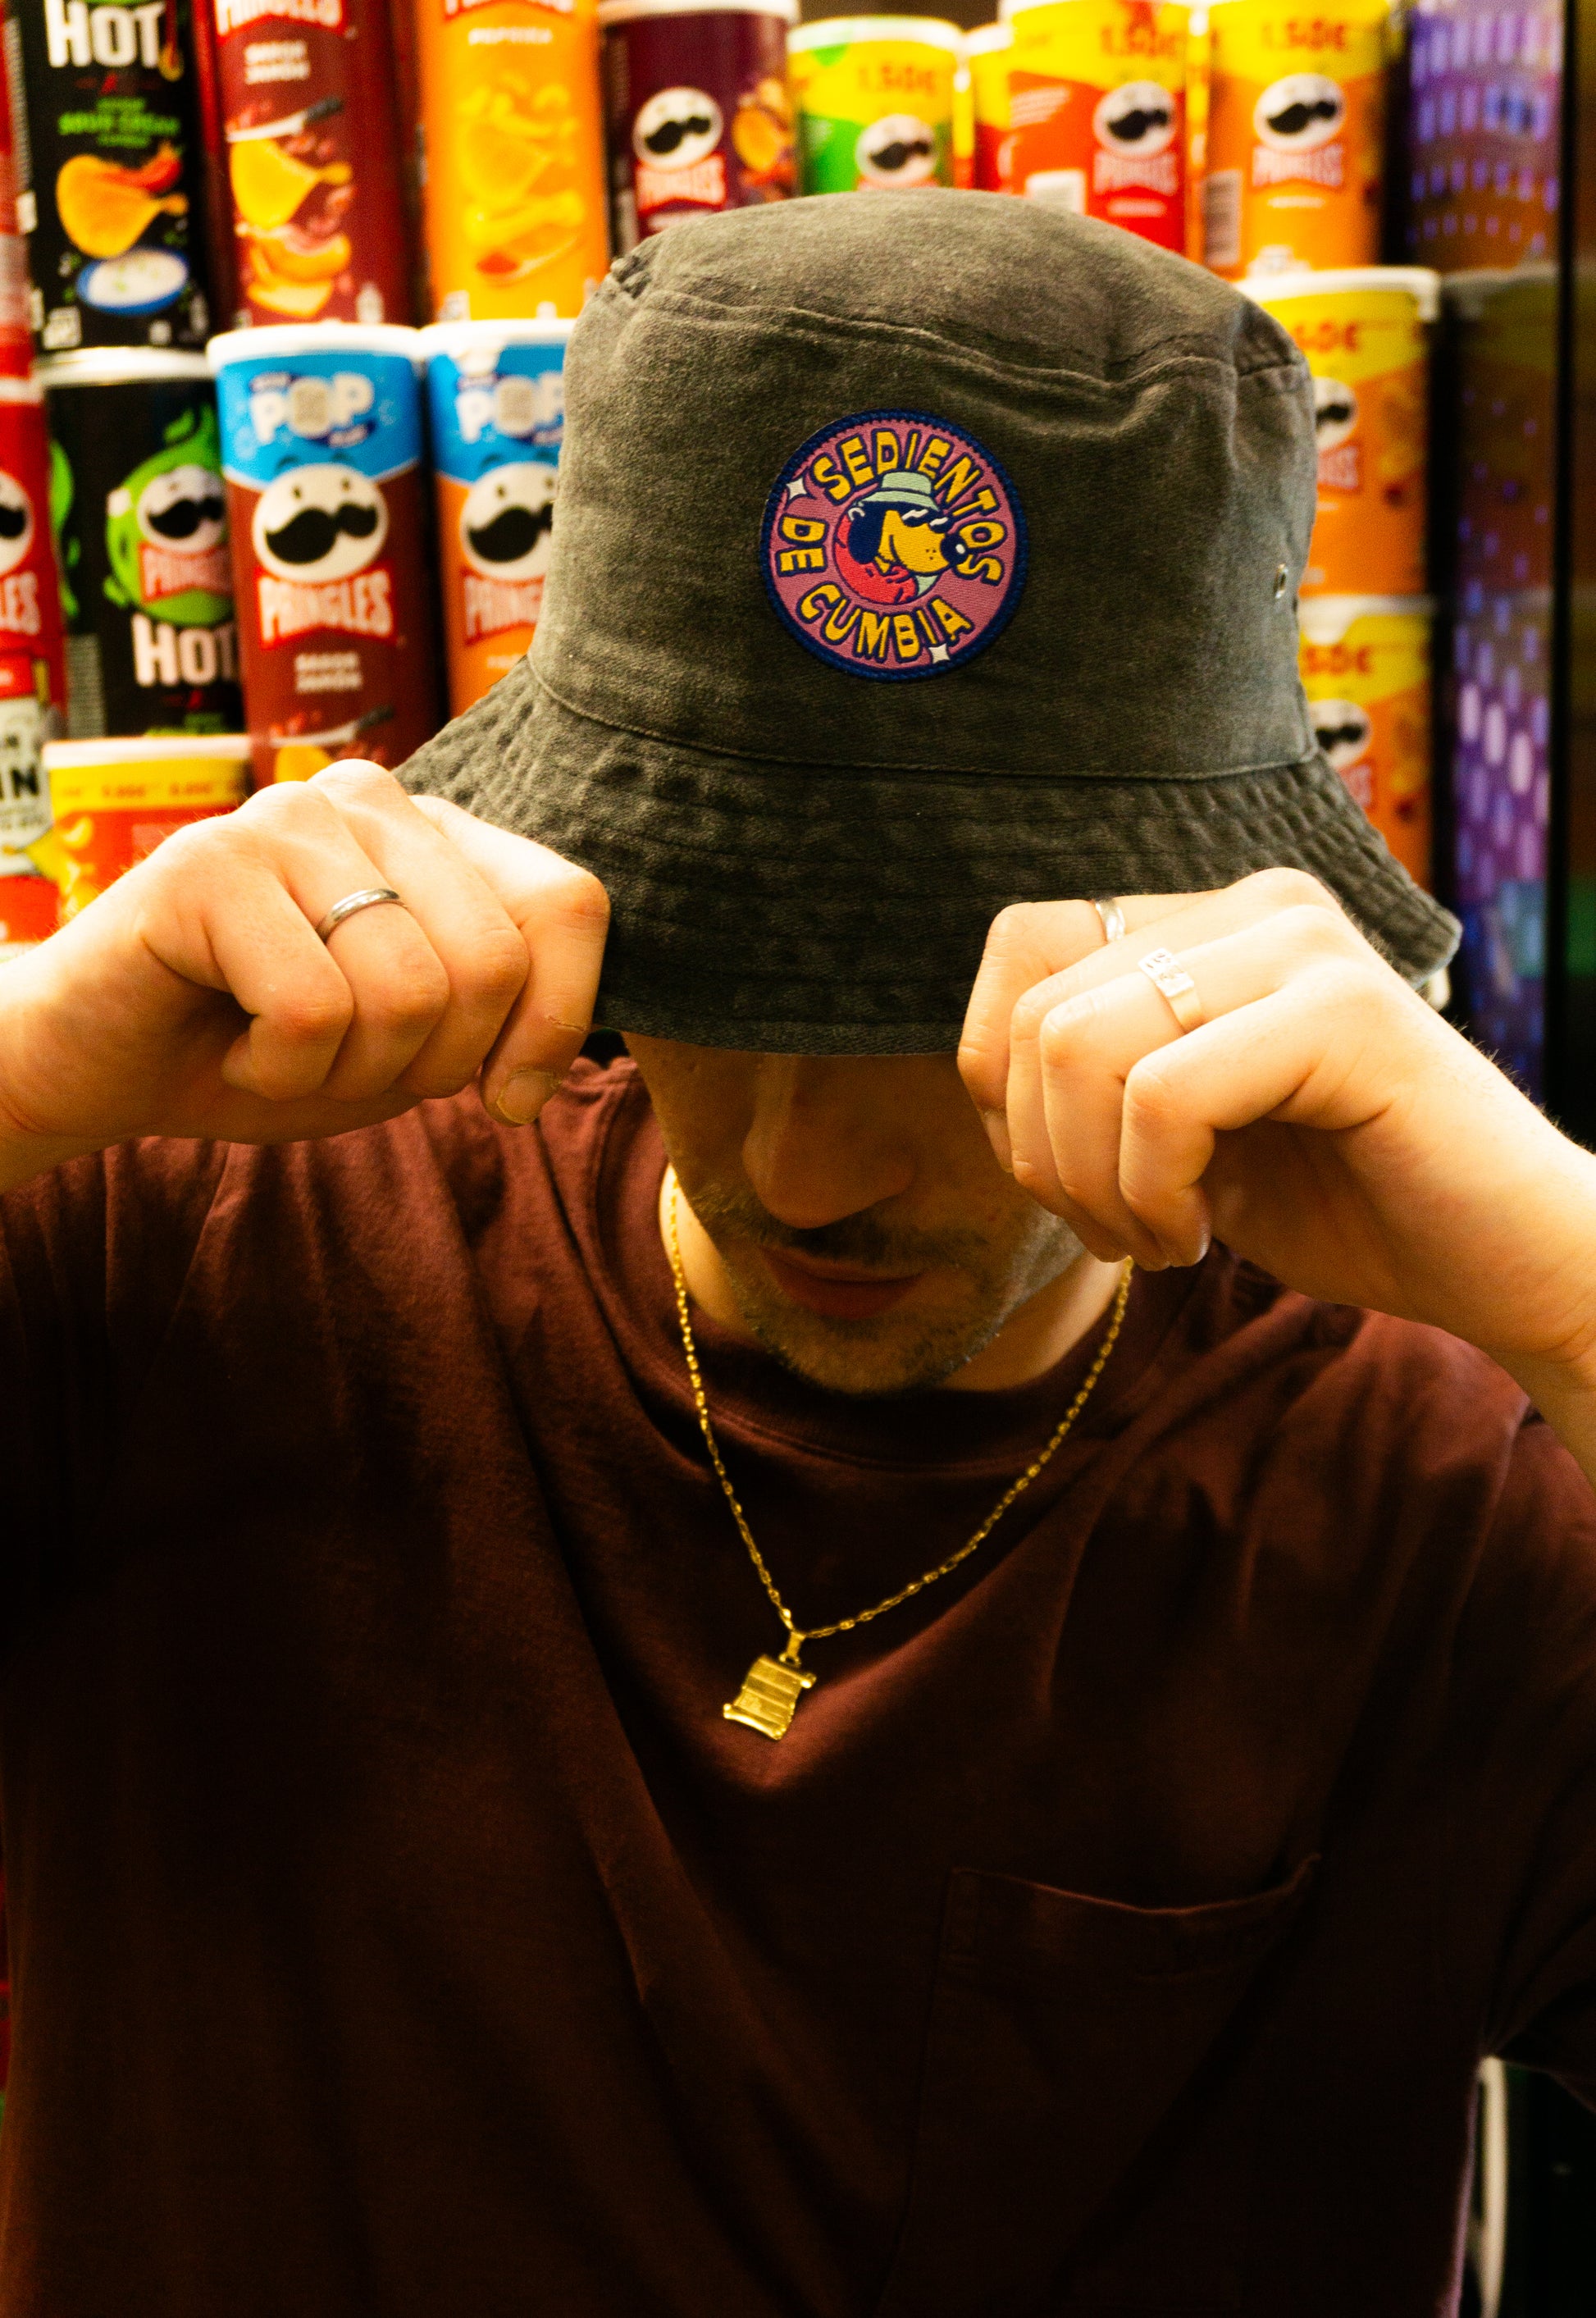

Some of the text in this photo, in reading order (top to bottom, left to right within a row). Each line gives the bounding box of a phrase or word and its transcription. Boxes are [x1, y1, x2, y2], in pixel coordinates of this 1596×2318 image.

[45, 1, 166, 68] HOT
[810, 429, 1007, 585] SEDIENTOS
[777, 515, 827, 574] DE
[259, 570, 393, 642] PRINGLES
[797, 582, 974, 660] CUMBIA
